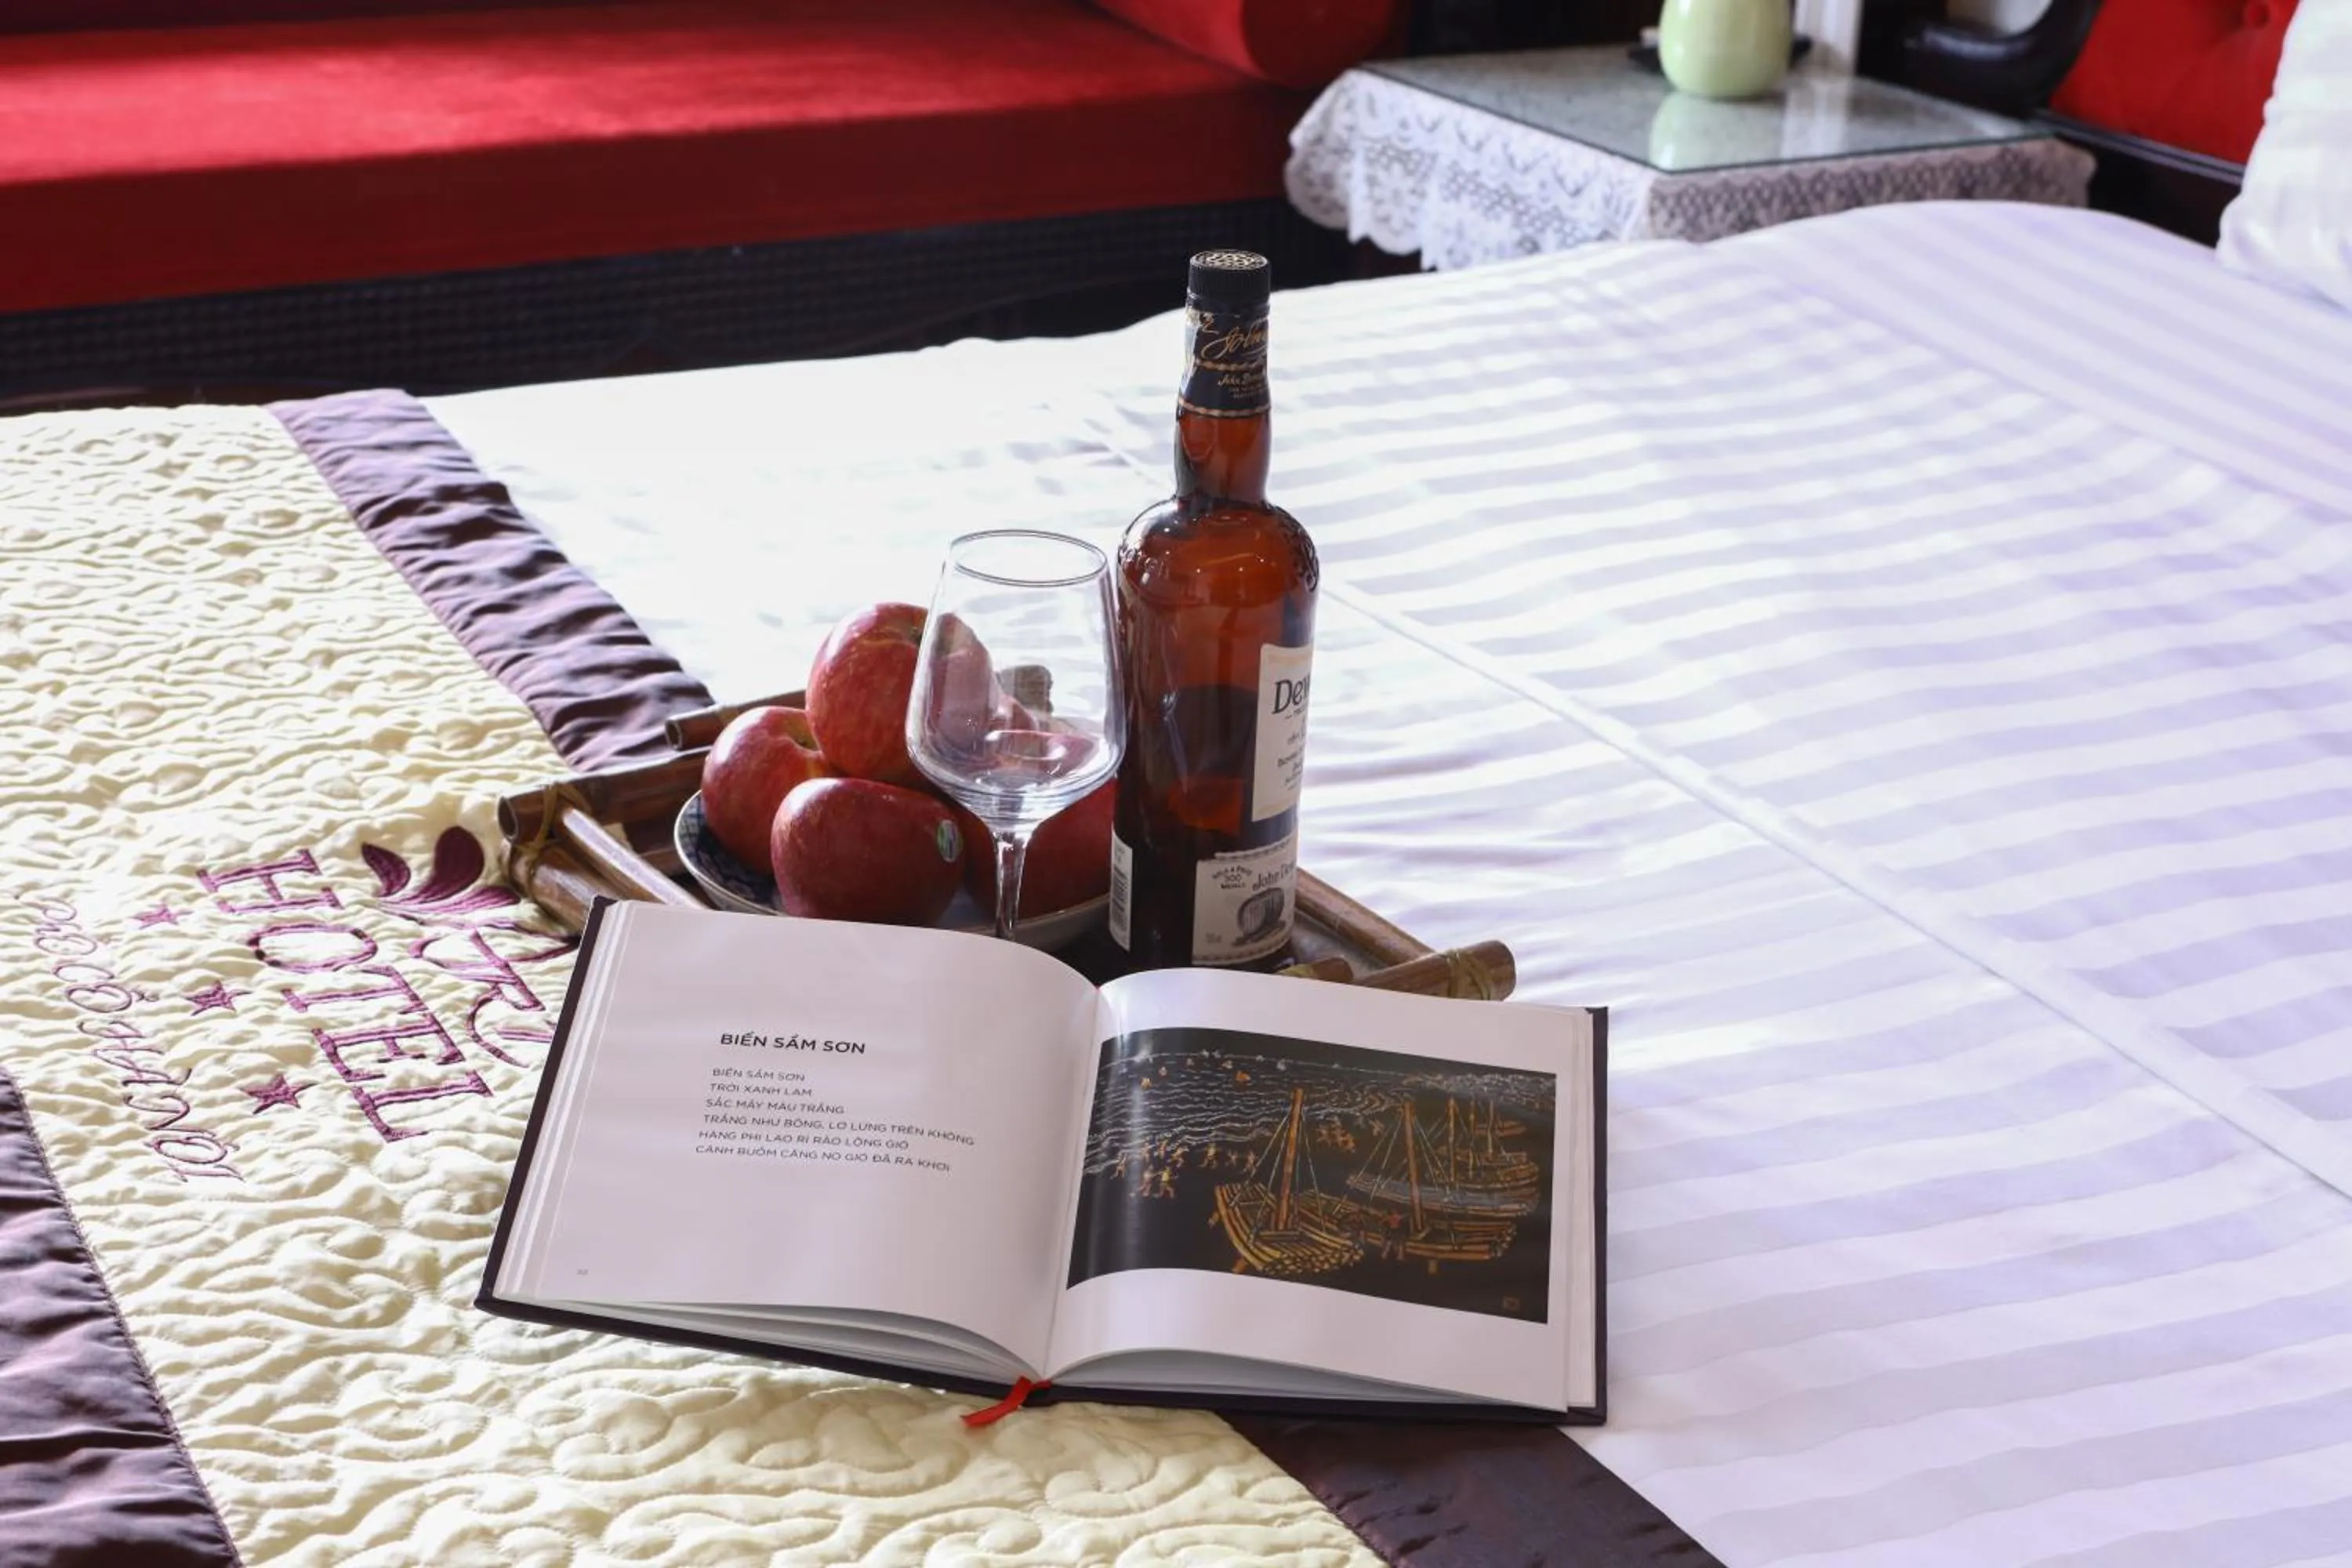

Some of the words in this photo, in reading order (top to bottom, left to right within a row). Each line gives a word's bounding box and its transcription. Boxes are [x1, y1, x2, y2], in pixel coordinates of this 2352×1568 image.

[196, 848, 495, 1142] HOTEL
[823, 1040, 866, 1054] SƠN
[744, 1086, 780, 1096] XANH
[784, 1087, 812, 1097] LAM
[741, 1133, 761, 1142] PHI
[765, 1134, 792, 1142] LAO
[895, 1156, 913, 1166] RA
